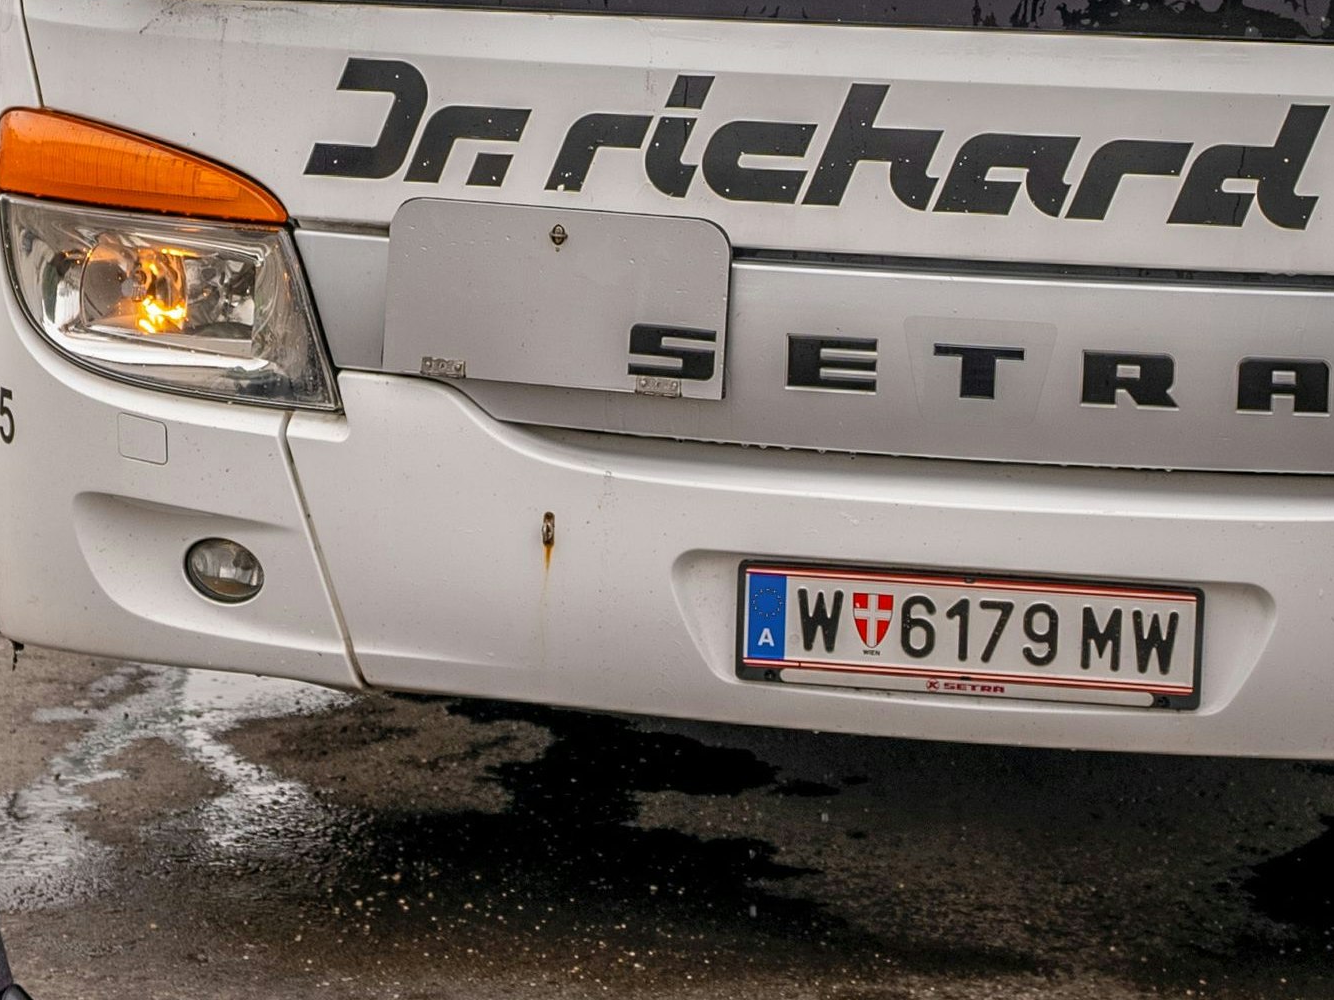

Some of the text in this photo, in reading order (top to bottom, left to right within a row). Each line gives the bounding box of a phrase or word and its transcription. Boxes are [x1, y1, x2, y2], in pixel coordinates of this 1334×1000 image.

[304, 57, 1331, 230] Dr. richard
[627, 323, 1331, 415] SETRA
[757, 627, 776, 648] A
[797, 588, 1179, 676] W 6179 MW
[943, 682, 1005, 694] SETRA
